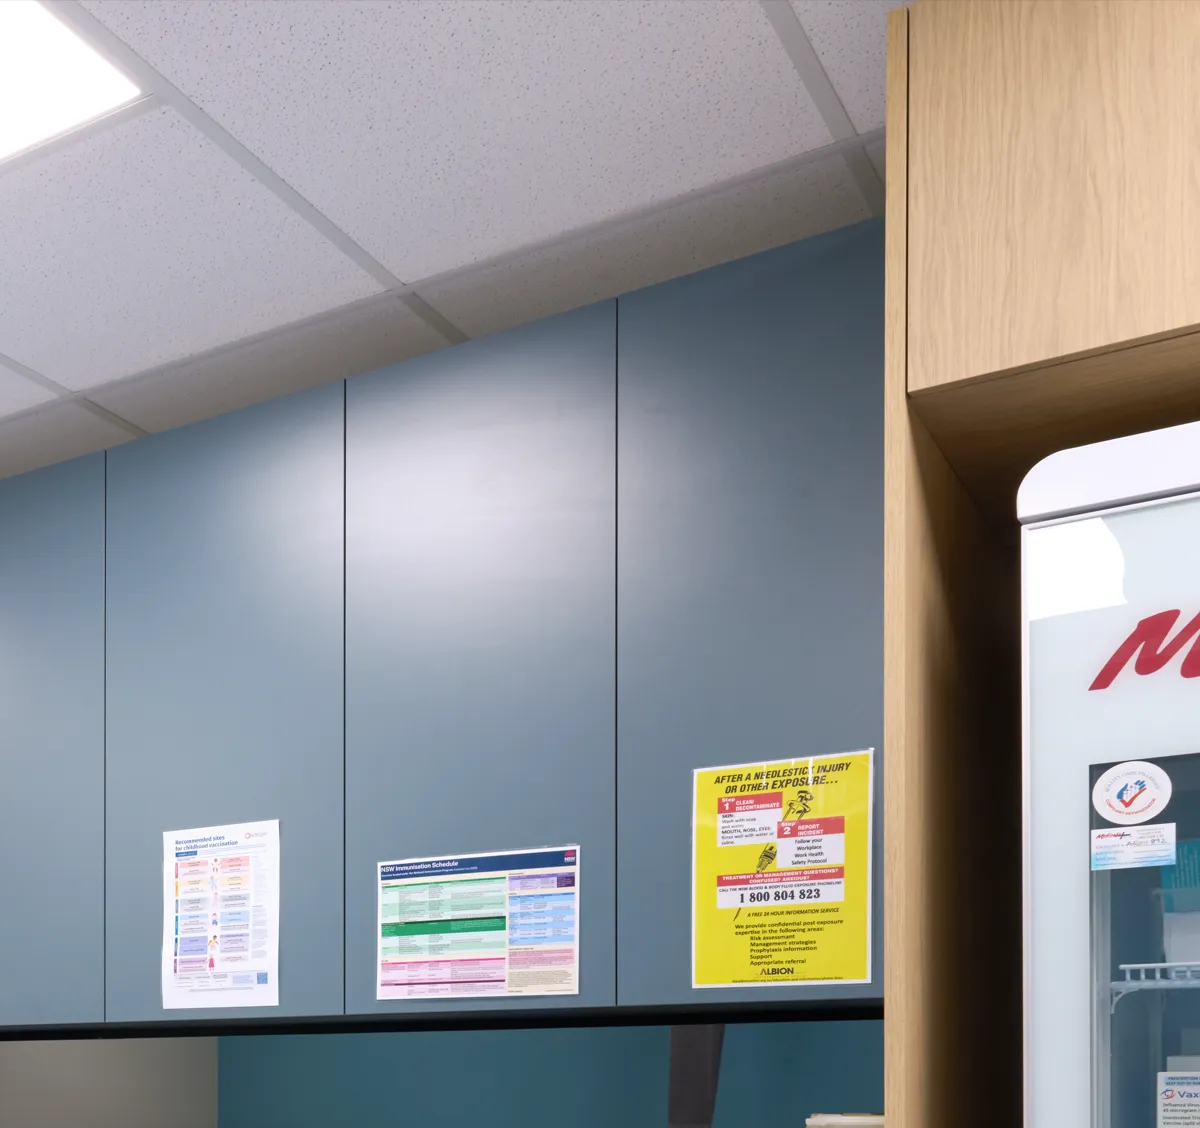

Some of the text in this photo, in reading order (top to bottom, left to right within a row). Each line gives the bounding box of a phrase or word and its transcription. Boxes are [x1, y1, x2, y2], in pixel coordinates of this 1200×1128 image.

[714, 763, 851, 784] AFTER A NEEDLESTICK INJURY
[725, 775, 838, 794] OR OTHER EXPOSURE...
[736, 802, 780, 811] DECONTAMINATE
[784, 827, 791, 835] 2
[175, 837, 211, 845] Recommended
[184, 843, 208, 851] childhood
[396, 863, 431, 871] Immunisation
[740, 889, 820, 903] 1 800 804 823
